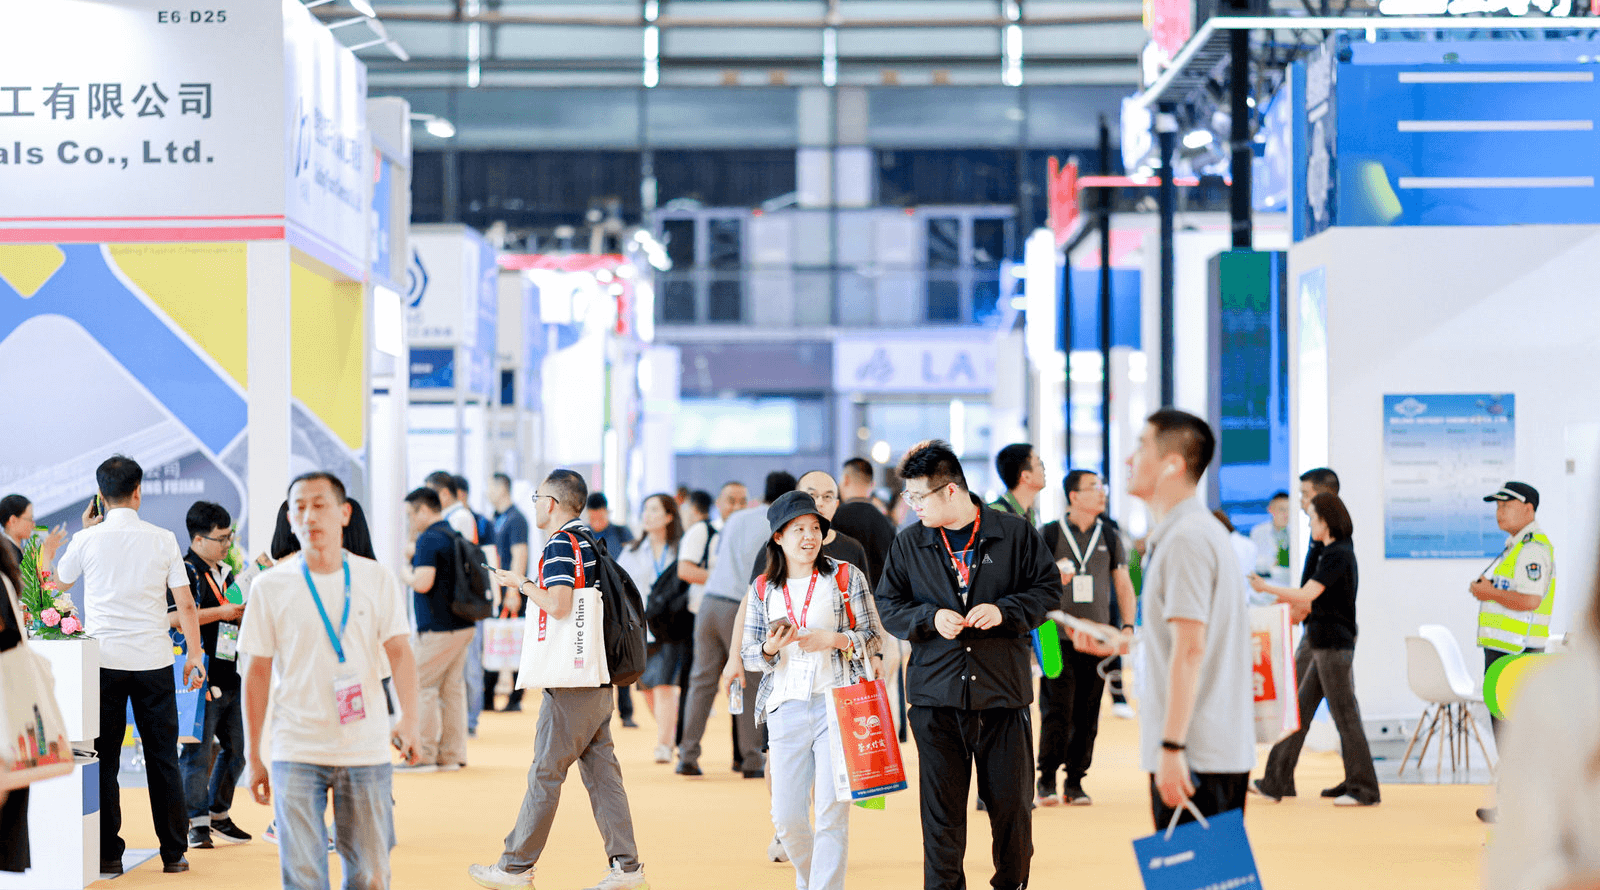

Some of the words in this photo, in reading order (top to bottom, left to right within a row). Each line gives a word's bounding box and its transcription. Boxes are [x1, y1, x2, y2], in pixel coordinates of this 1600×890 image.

[0, 82, 213, 120] 工有限公司
[57, 140, 129, 169] Co.,
[143, 140, 214, 164] Ltd.
[576, 598, 584, 628] China
[575, 631, 584, 655] wire
